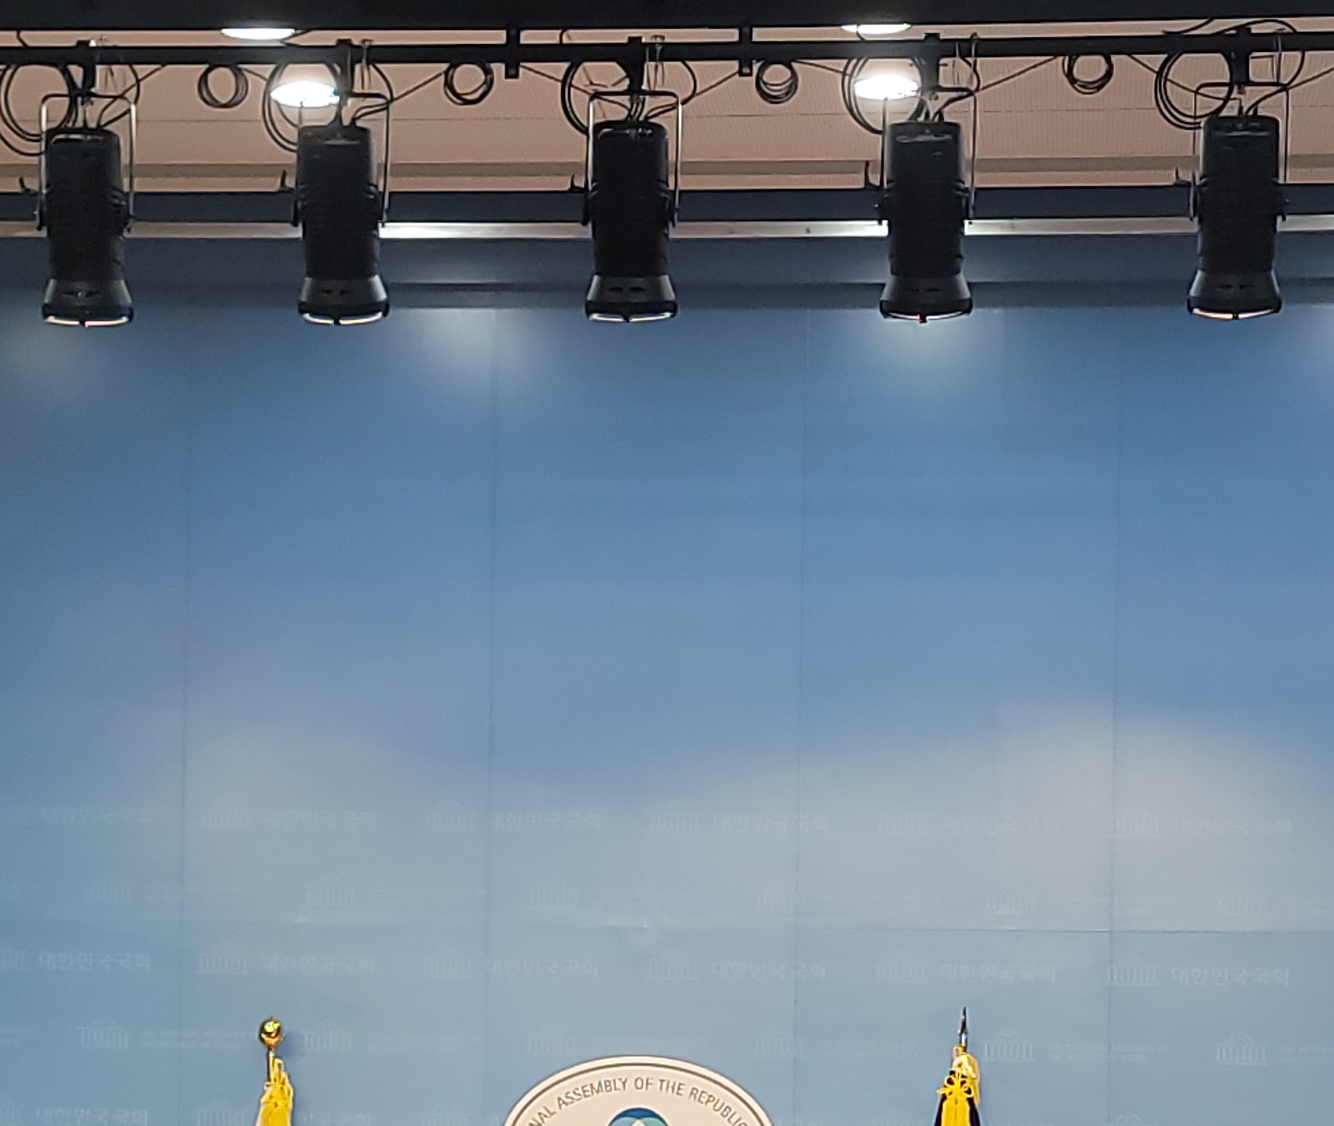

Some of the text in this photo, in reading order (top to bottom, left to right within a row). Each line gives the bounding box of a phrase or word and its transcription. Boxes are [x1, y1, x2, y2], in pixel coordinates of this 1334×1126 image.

[557, 1077, 628, 1111] ASSEMBLY
[634, 1076, 654, 1090] OF
[658, 1078, 686, 1097] THE
